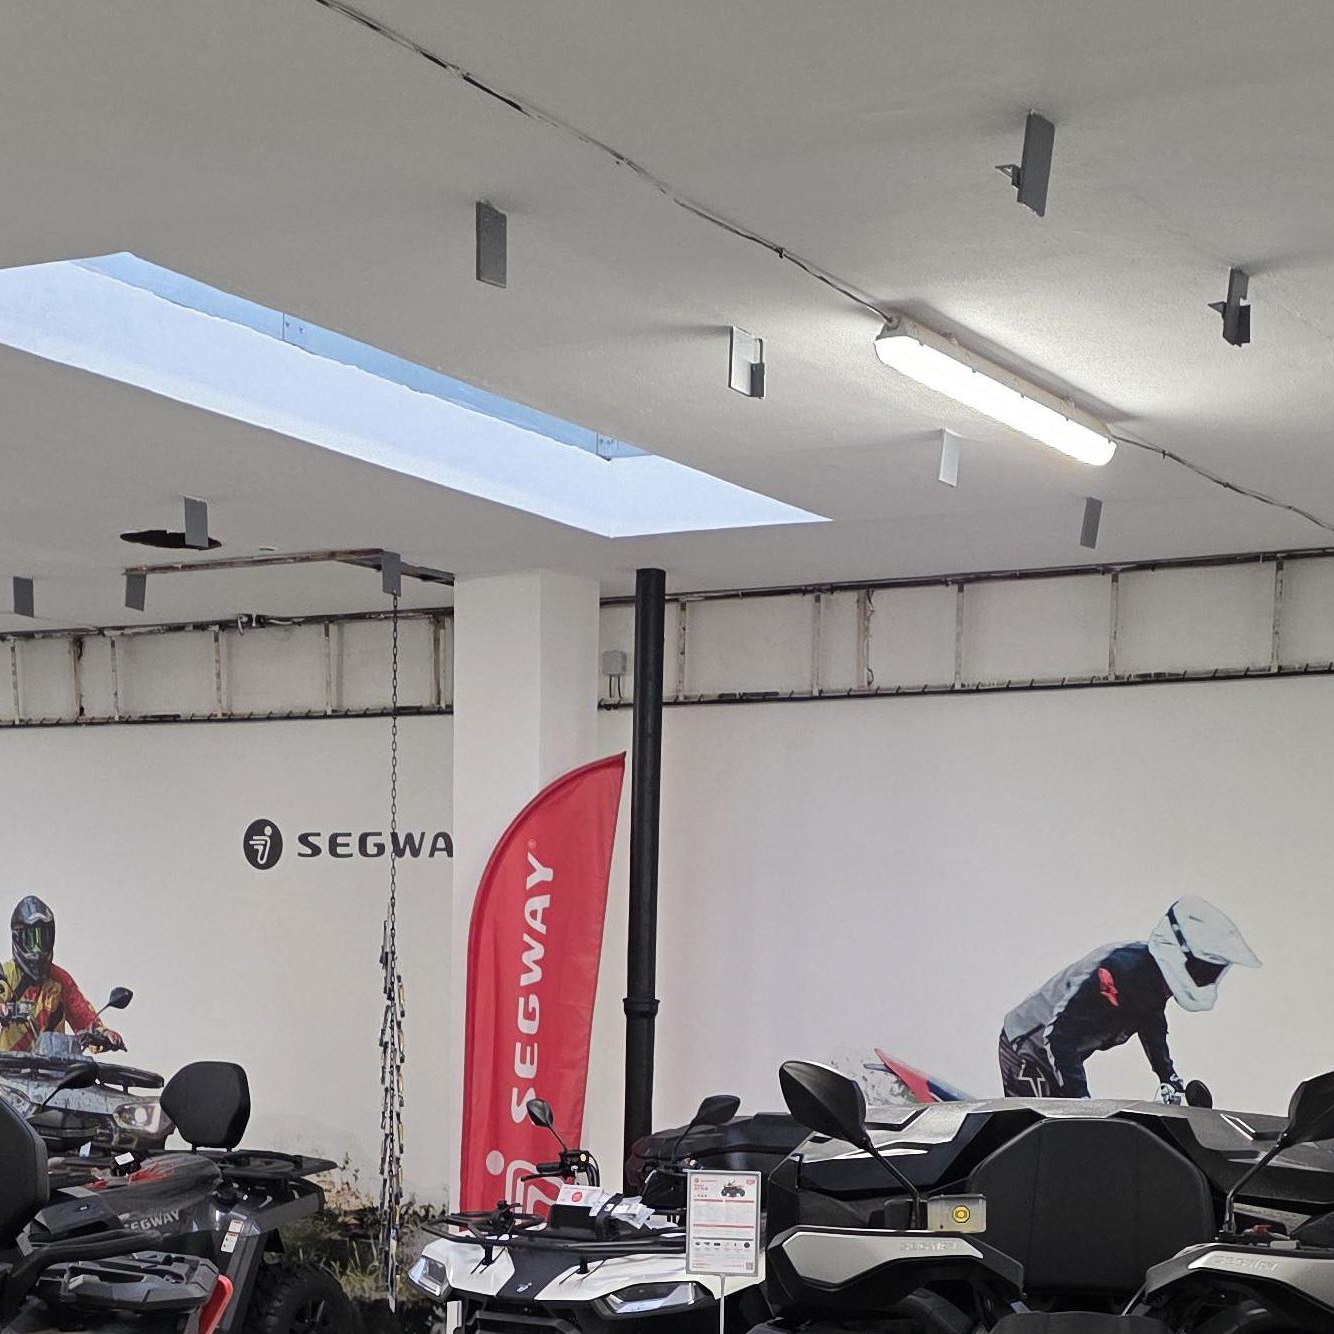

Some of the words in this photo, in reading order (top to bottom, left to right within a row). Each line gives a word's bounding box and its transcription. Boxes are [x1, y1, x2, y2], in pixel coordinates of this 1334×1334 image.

[297, 831, 454, 859] SEGWA
[511, 852, 556, 1125] SEGWAY
[124, 1210, 181, 1231] EGWAY
